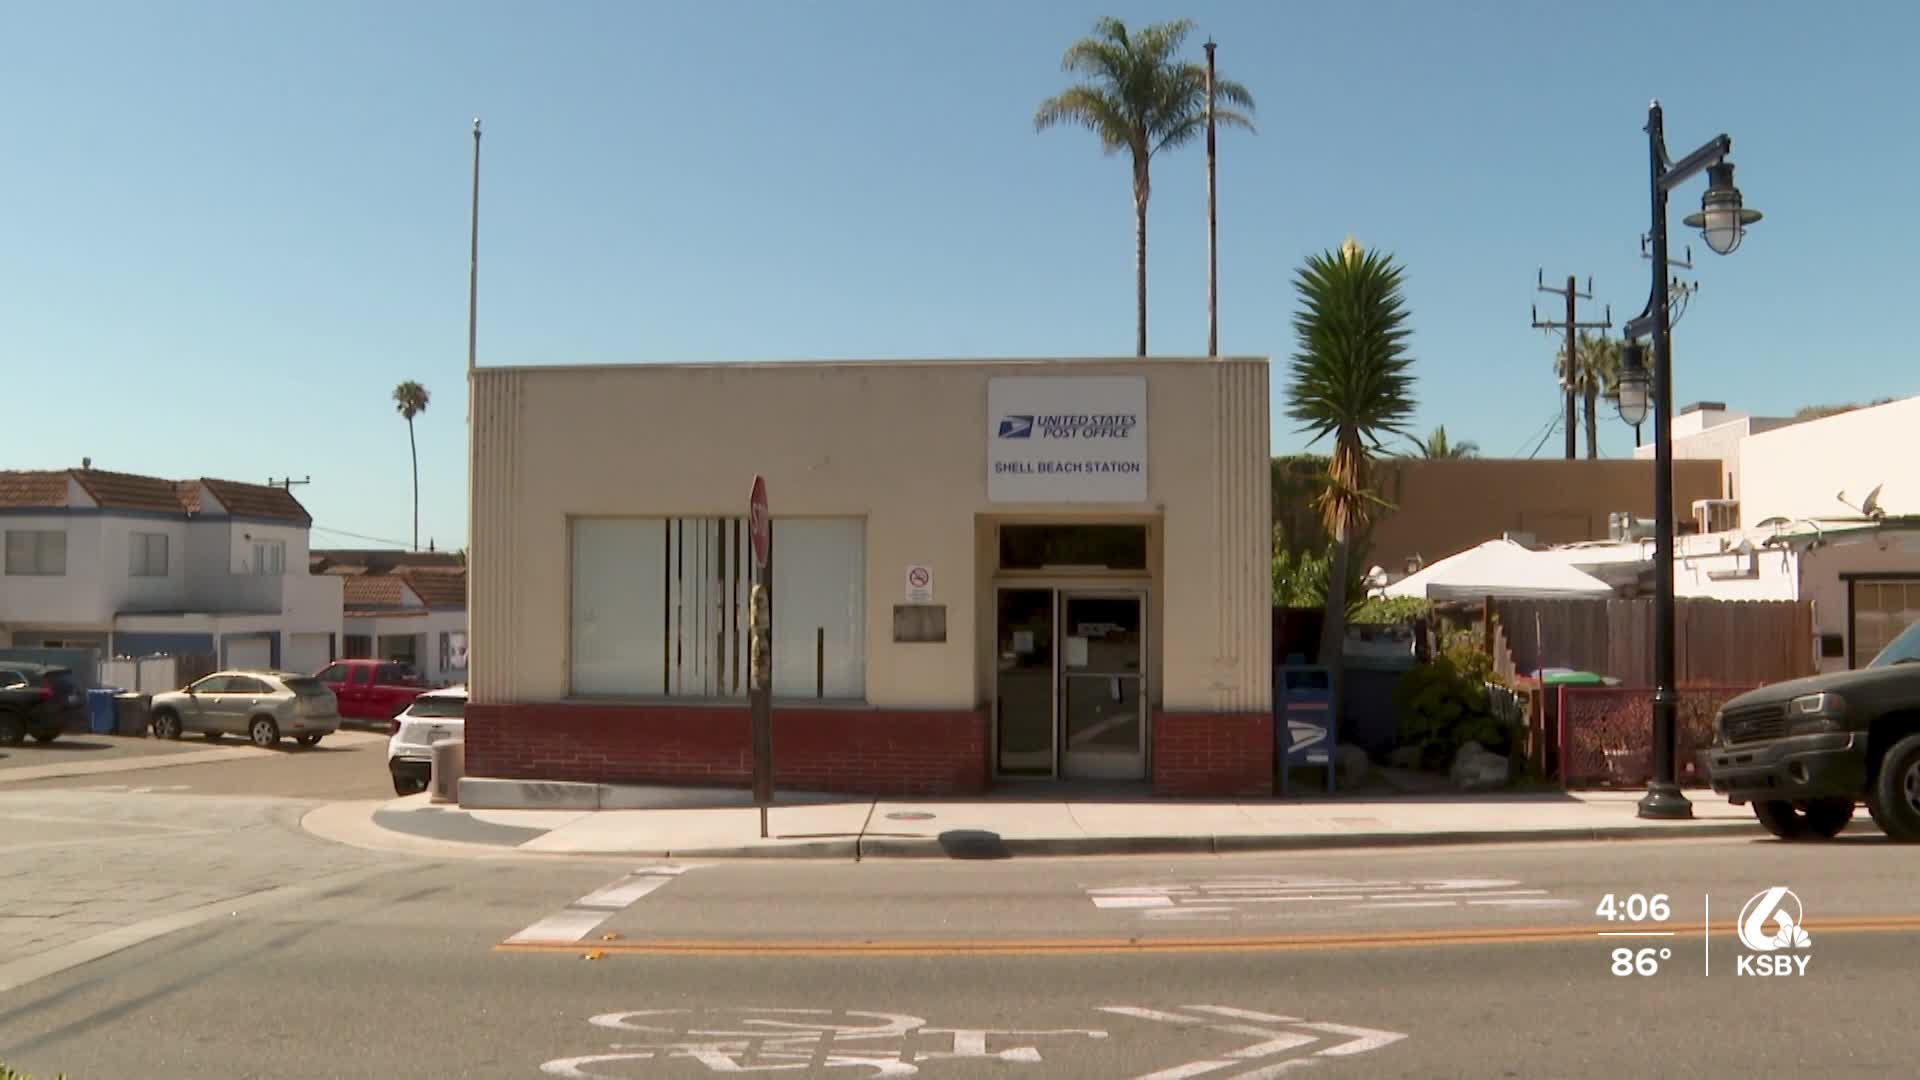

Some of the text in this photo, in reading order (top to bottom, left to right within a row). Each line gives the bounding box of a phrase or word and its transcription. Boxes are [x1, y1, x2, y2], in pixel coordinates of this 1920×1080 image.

[1037, 414, 1137, 427] UNITED STATES
[1043, 427, 1130, 439] POST OFFICE
[995, 461, 1140, 474] SHELL BEACH STATION
